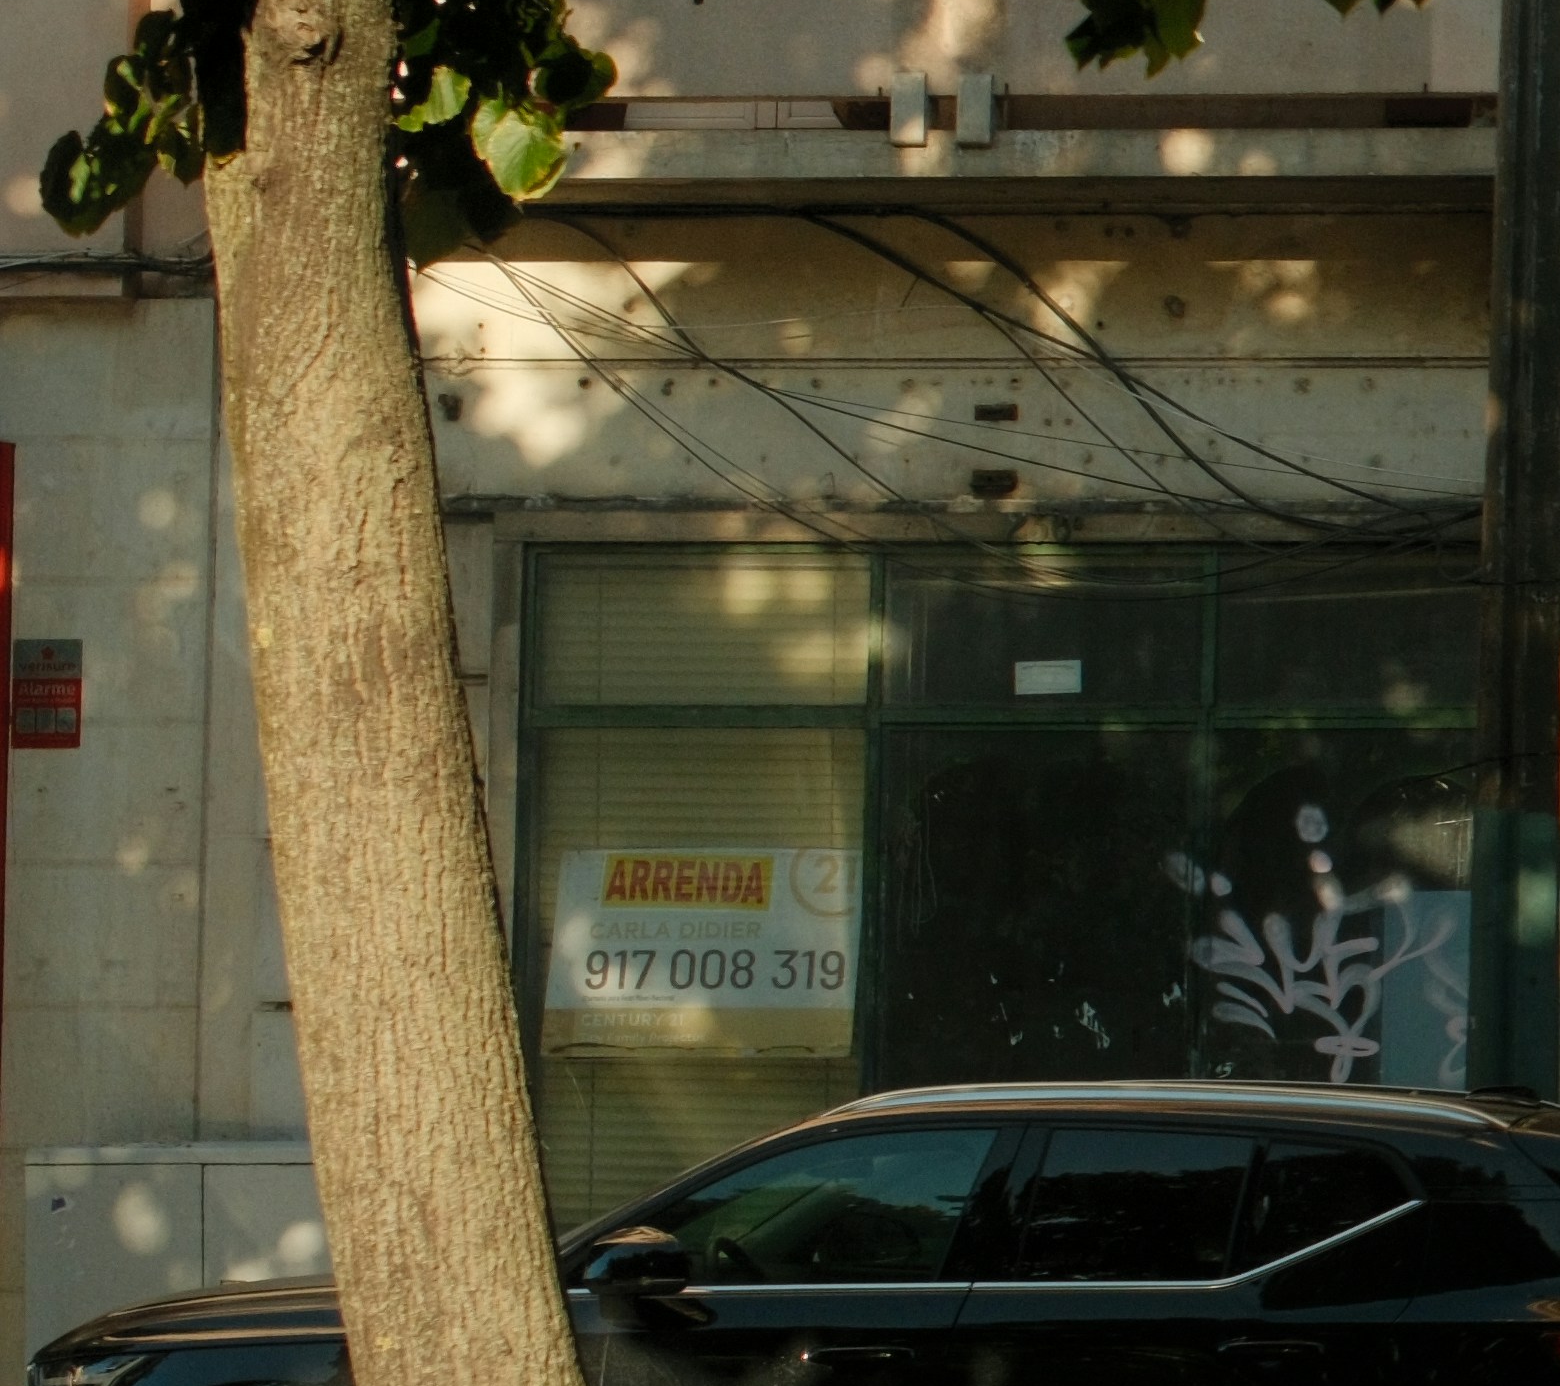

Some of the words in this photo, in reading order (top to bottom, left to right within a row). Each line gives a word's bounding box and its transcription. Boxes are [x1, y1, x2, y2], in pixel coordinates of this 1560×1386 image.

[18, 681, 76, 696] Alarme
[605, 859, 764, 904] ARRENDA
[813, 856, 857, 894] 21
[590, 921, 671, 941] CARLA
[680, 920, 762, 939] DIDIER
[584, 949, 657, 990] 917
[669, 948, 756, 990] 008
[771, 949, 845, 990] 319
[581, 1012, 664, 1027] CENTURY
[669, 1013, 684, 1027] 21
